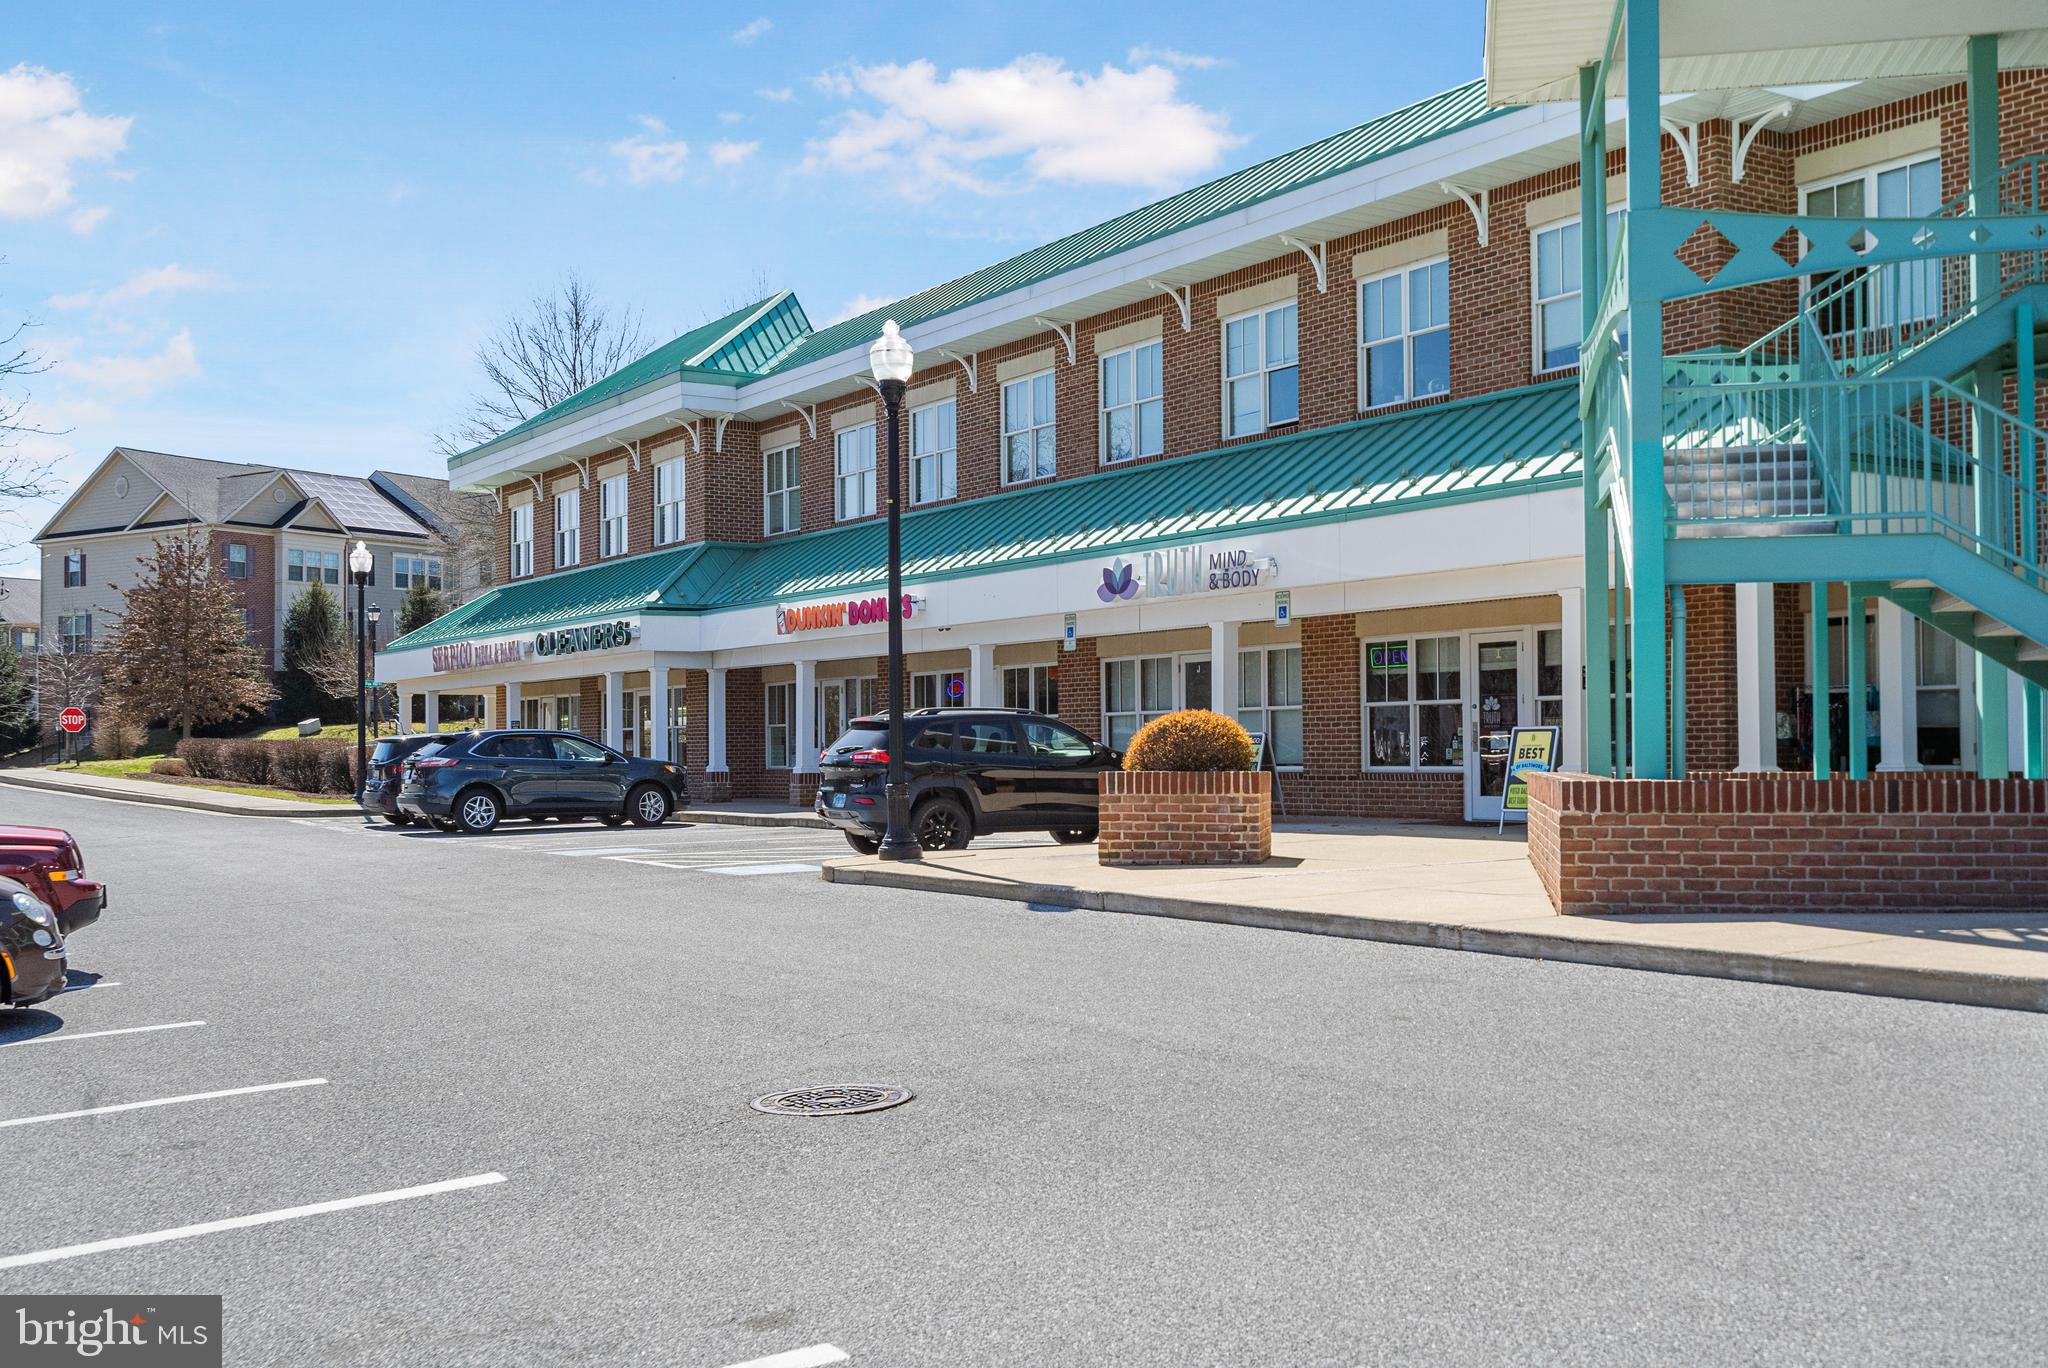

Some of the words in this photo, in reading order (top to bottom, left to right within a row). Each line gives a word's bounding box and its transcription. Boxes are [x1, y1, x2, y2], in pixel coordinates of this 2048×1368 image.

[1209, 549, 1247, 570] MIND
[1143, 545, 1206, 598] TRUTH
[1209, 573, 1219, 591] &
[1222, 568, 1260, 589] BODY
[848, 593, 912, 626] DONUS
[432, 641, 473, 672] SERPICO
[1372, 650, 1409, 665] OPEN
[62, 715, 84, 724] STOP
[1518, 747, 1545, 759] BEST
